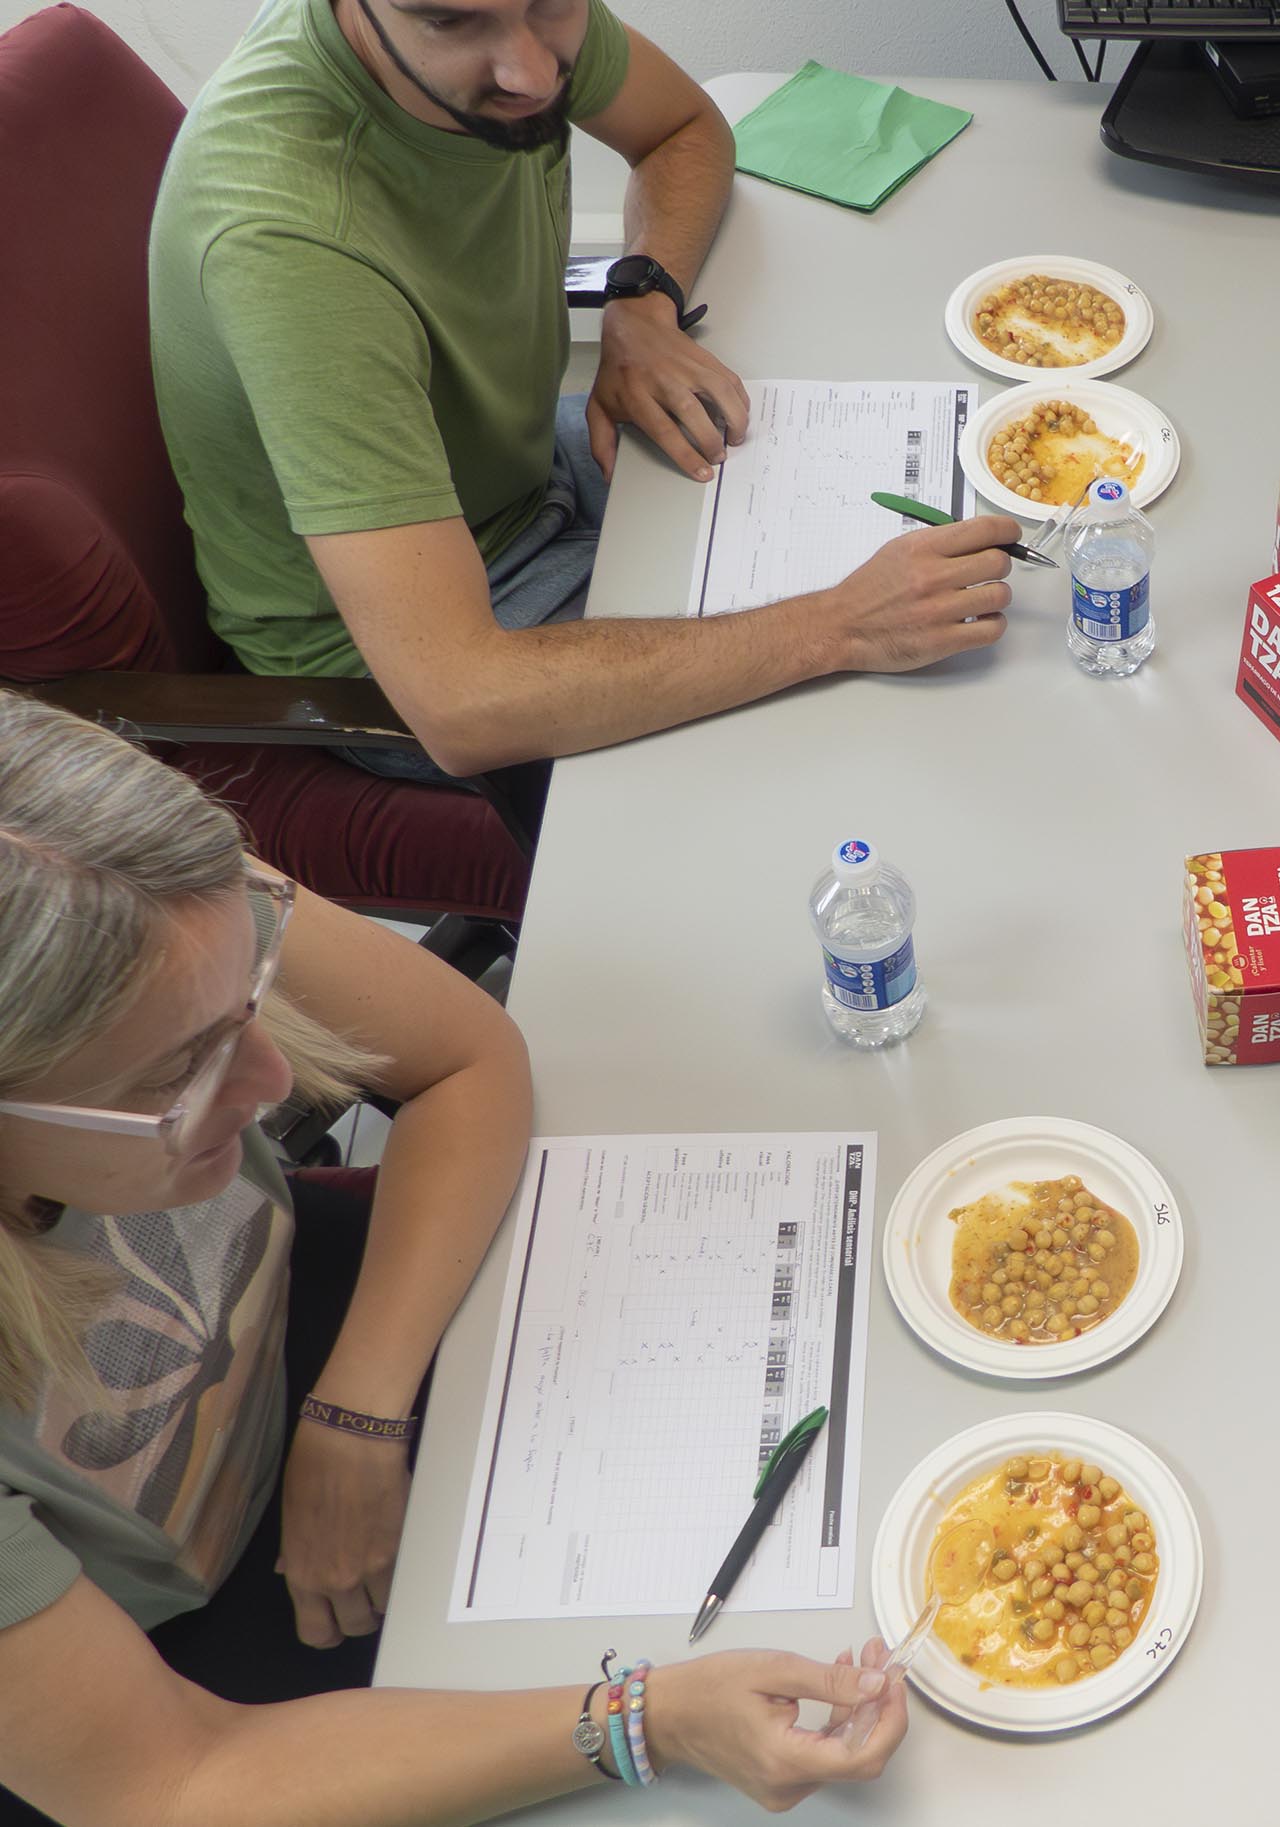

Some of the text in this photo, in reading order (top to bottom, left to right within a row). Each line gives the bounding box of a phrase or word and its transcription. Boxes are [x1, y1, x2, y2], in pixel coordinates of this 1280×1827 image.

[1242, 897, 1264, 937] DAN
[1252, 1014, 1269, 1043] DAN
[846, 1209, 856, 1234] Análisis
[844, 1235, 854, 1266] sensorial
[338, 1412, 406, 1435] PODER
